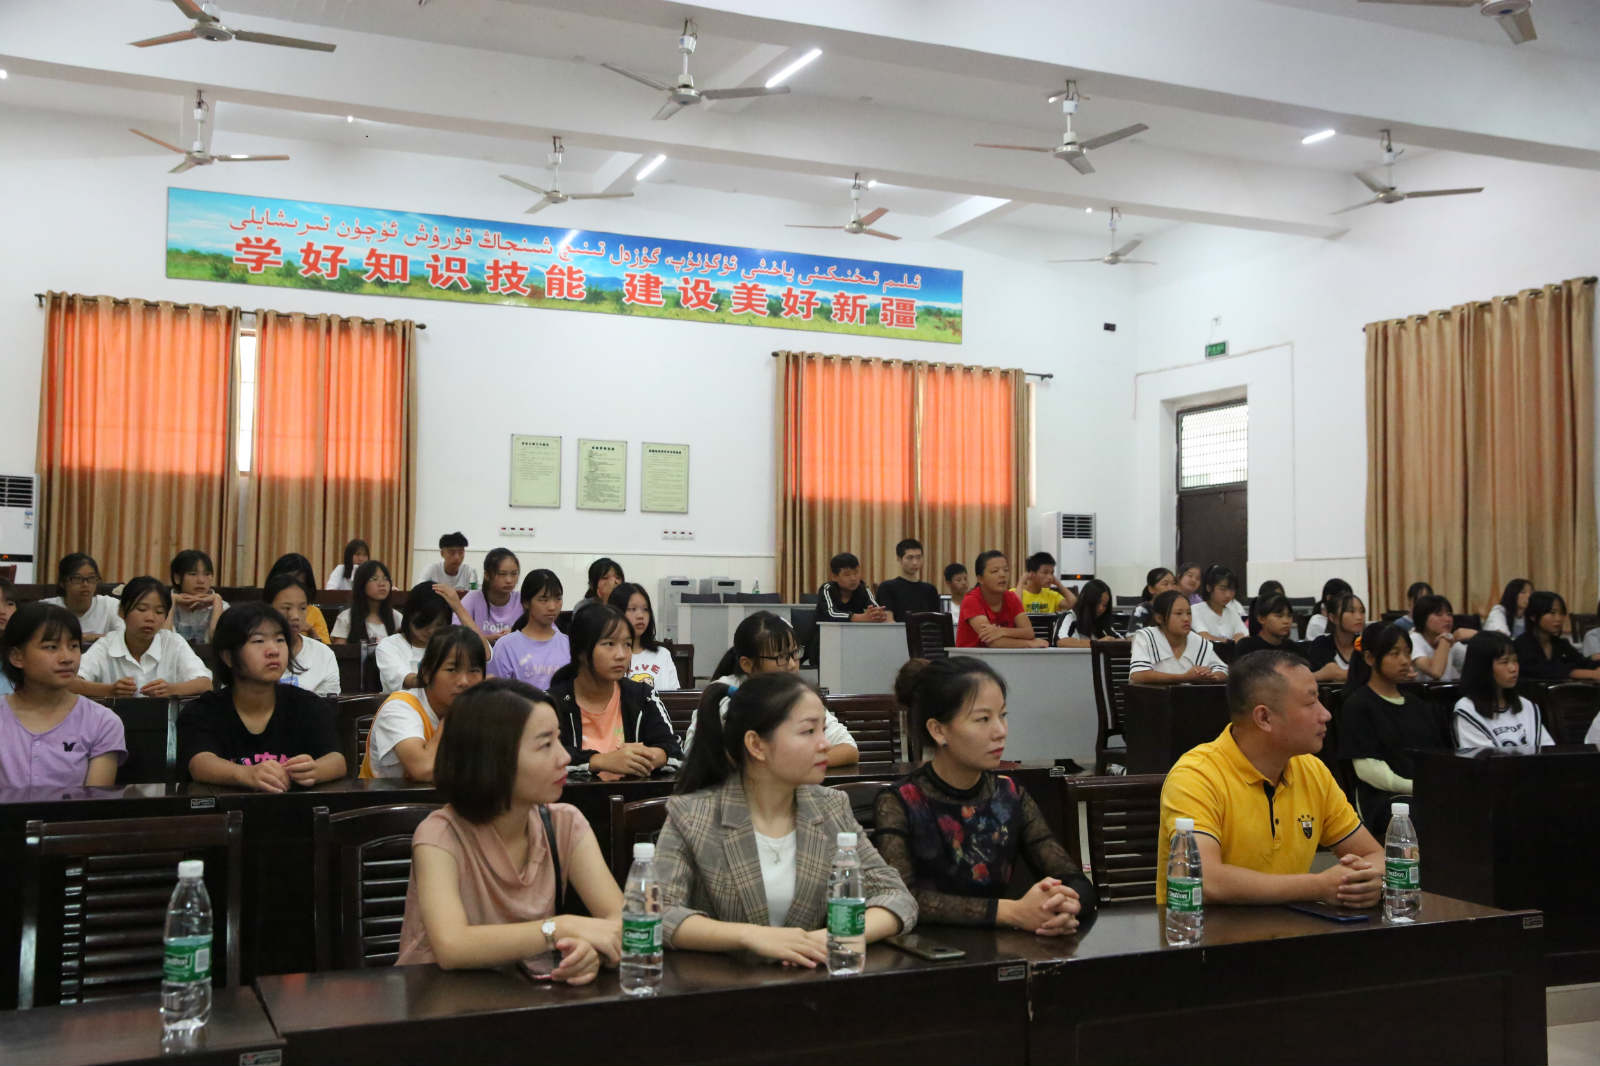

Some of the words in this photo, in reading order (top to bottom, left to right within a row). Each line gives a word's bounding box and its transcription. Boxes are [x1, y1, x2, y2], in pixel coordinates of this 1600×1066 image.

[336, 218, 398, 243] ئۈچۈن
[403, 223, 473, 251] قۇرۇش
[478, 230, 553, 256] شىنجاڭ
[234, 236, 587, 300] 学好知识技能
[622, 271, 918, 330] 建设美好新疆
